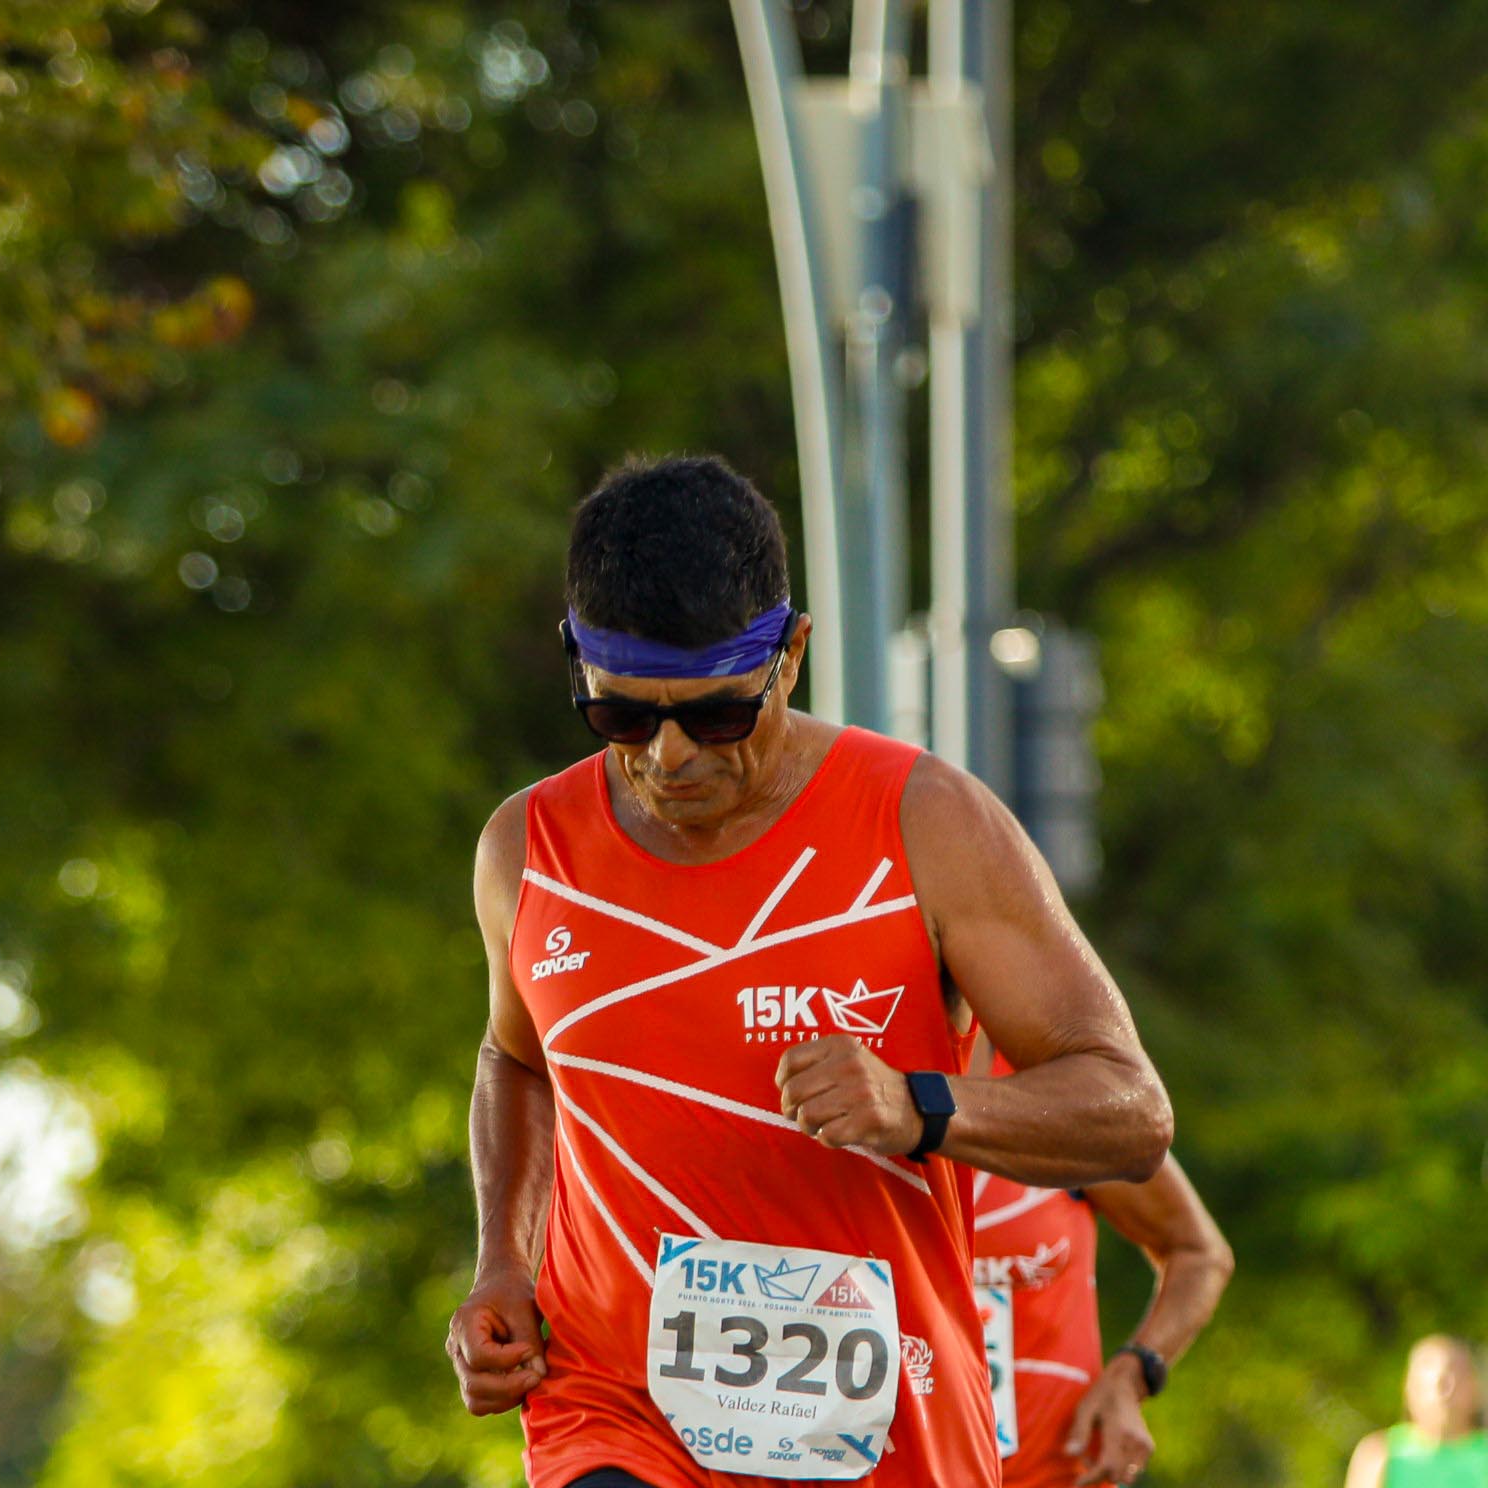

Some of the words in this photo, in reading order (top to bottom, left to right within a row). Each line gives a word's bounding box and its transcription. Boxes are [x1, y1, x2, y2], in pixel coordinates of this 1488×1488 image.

[736, 986, 819, 1029] 15K
[745, 1031, 819, 1044] PUERTO
[680, 1258, 748, 1295] 15K
[830, 1285, 862, 1304] 15K
[659, 1310, 889, 1400] 1320
[717, 1394, 766, 1413] Valdez
[771, 1400, 817, 1419] Rafael
[680, 1426, 753, 1455] osde
